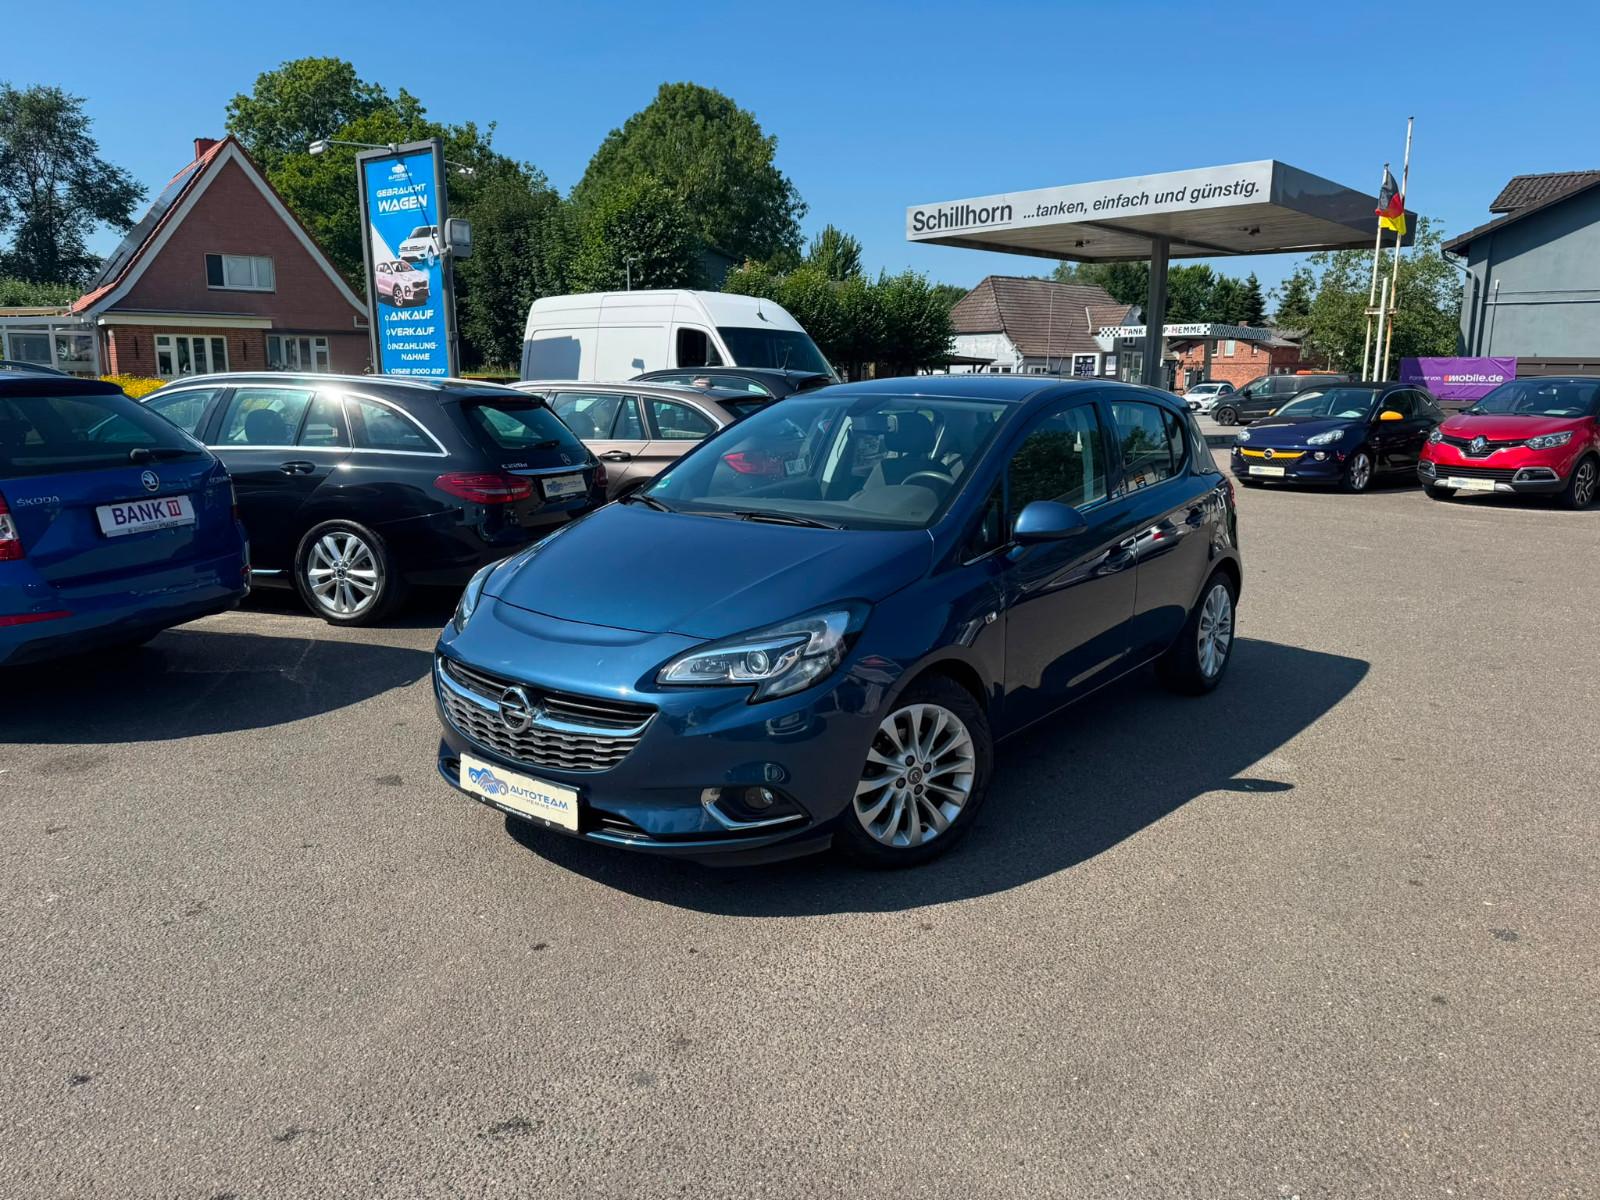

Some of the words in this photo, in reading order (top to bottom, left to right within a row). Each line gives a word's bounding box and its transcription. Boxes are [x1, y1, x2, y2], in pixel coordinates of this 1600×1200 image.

[376, 183, 426, 198] GEBRAUCHT
[378, 194, 428, 213] WAGEN
[912, 204, 1013, 232] Schillhorn
[1093, 191, 1149, 211] einfach
[1154, 186, 1187, 204] und
[1190, 179, 1260, 204] günstig.
[390, 309, 434, 321] ANKAUF
[390, 326, 435, 337] VERKAUF
[401, 353, 431, 361] NAHME
[1447, 373, 1504, 383] mobile.de
[112, 502, 167, 526] BANK
[510, 784, 569, 810] AUTOTEAM
